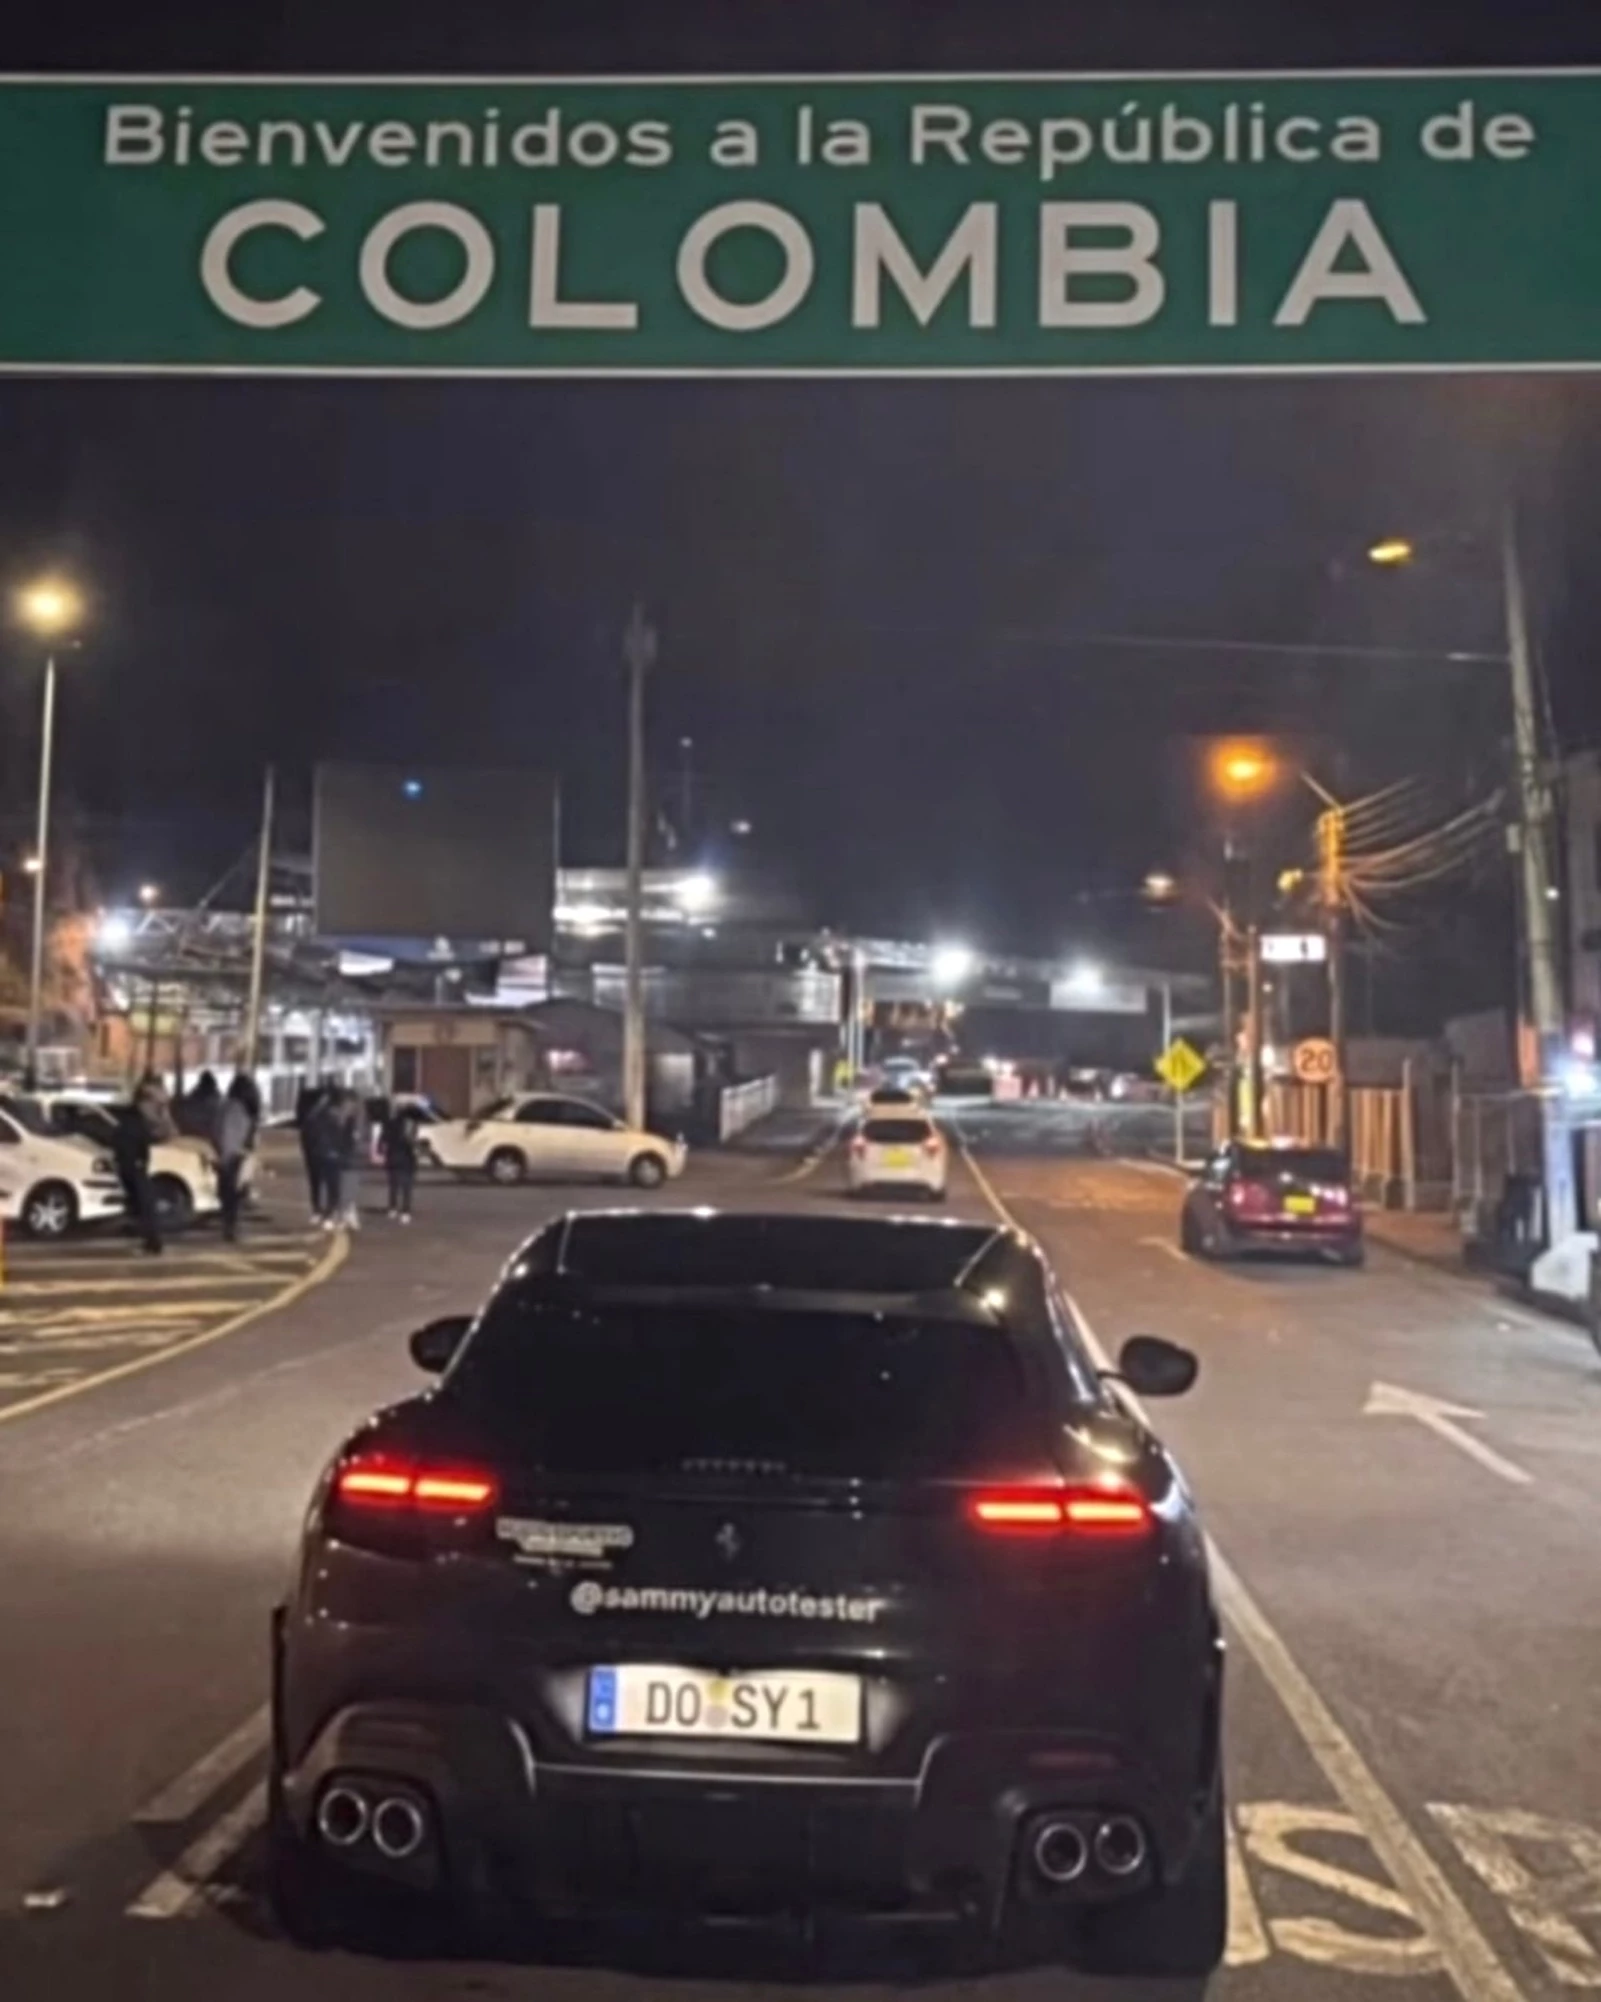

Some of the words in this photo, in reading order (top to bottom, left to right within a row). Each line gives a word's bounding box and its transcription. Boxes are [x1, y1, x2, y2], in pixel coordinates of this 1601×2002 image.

[105, 105, 672, 166] Bienvenidos
[710, 120, 758, 166] a
[798, 102, 870, 166] la
[911, 101, 1380, 182] República
[1420, 100, 1534, 160] de
[200, 198, 1427, 331] COLOMBIA
[1301, 1047, 1332, 1073] 20
[569, 1580, 883, 1623] @sammyautotester
[645, 1681, 702, 1727] DO
